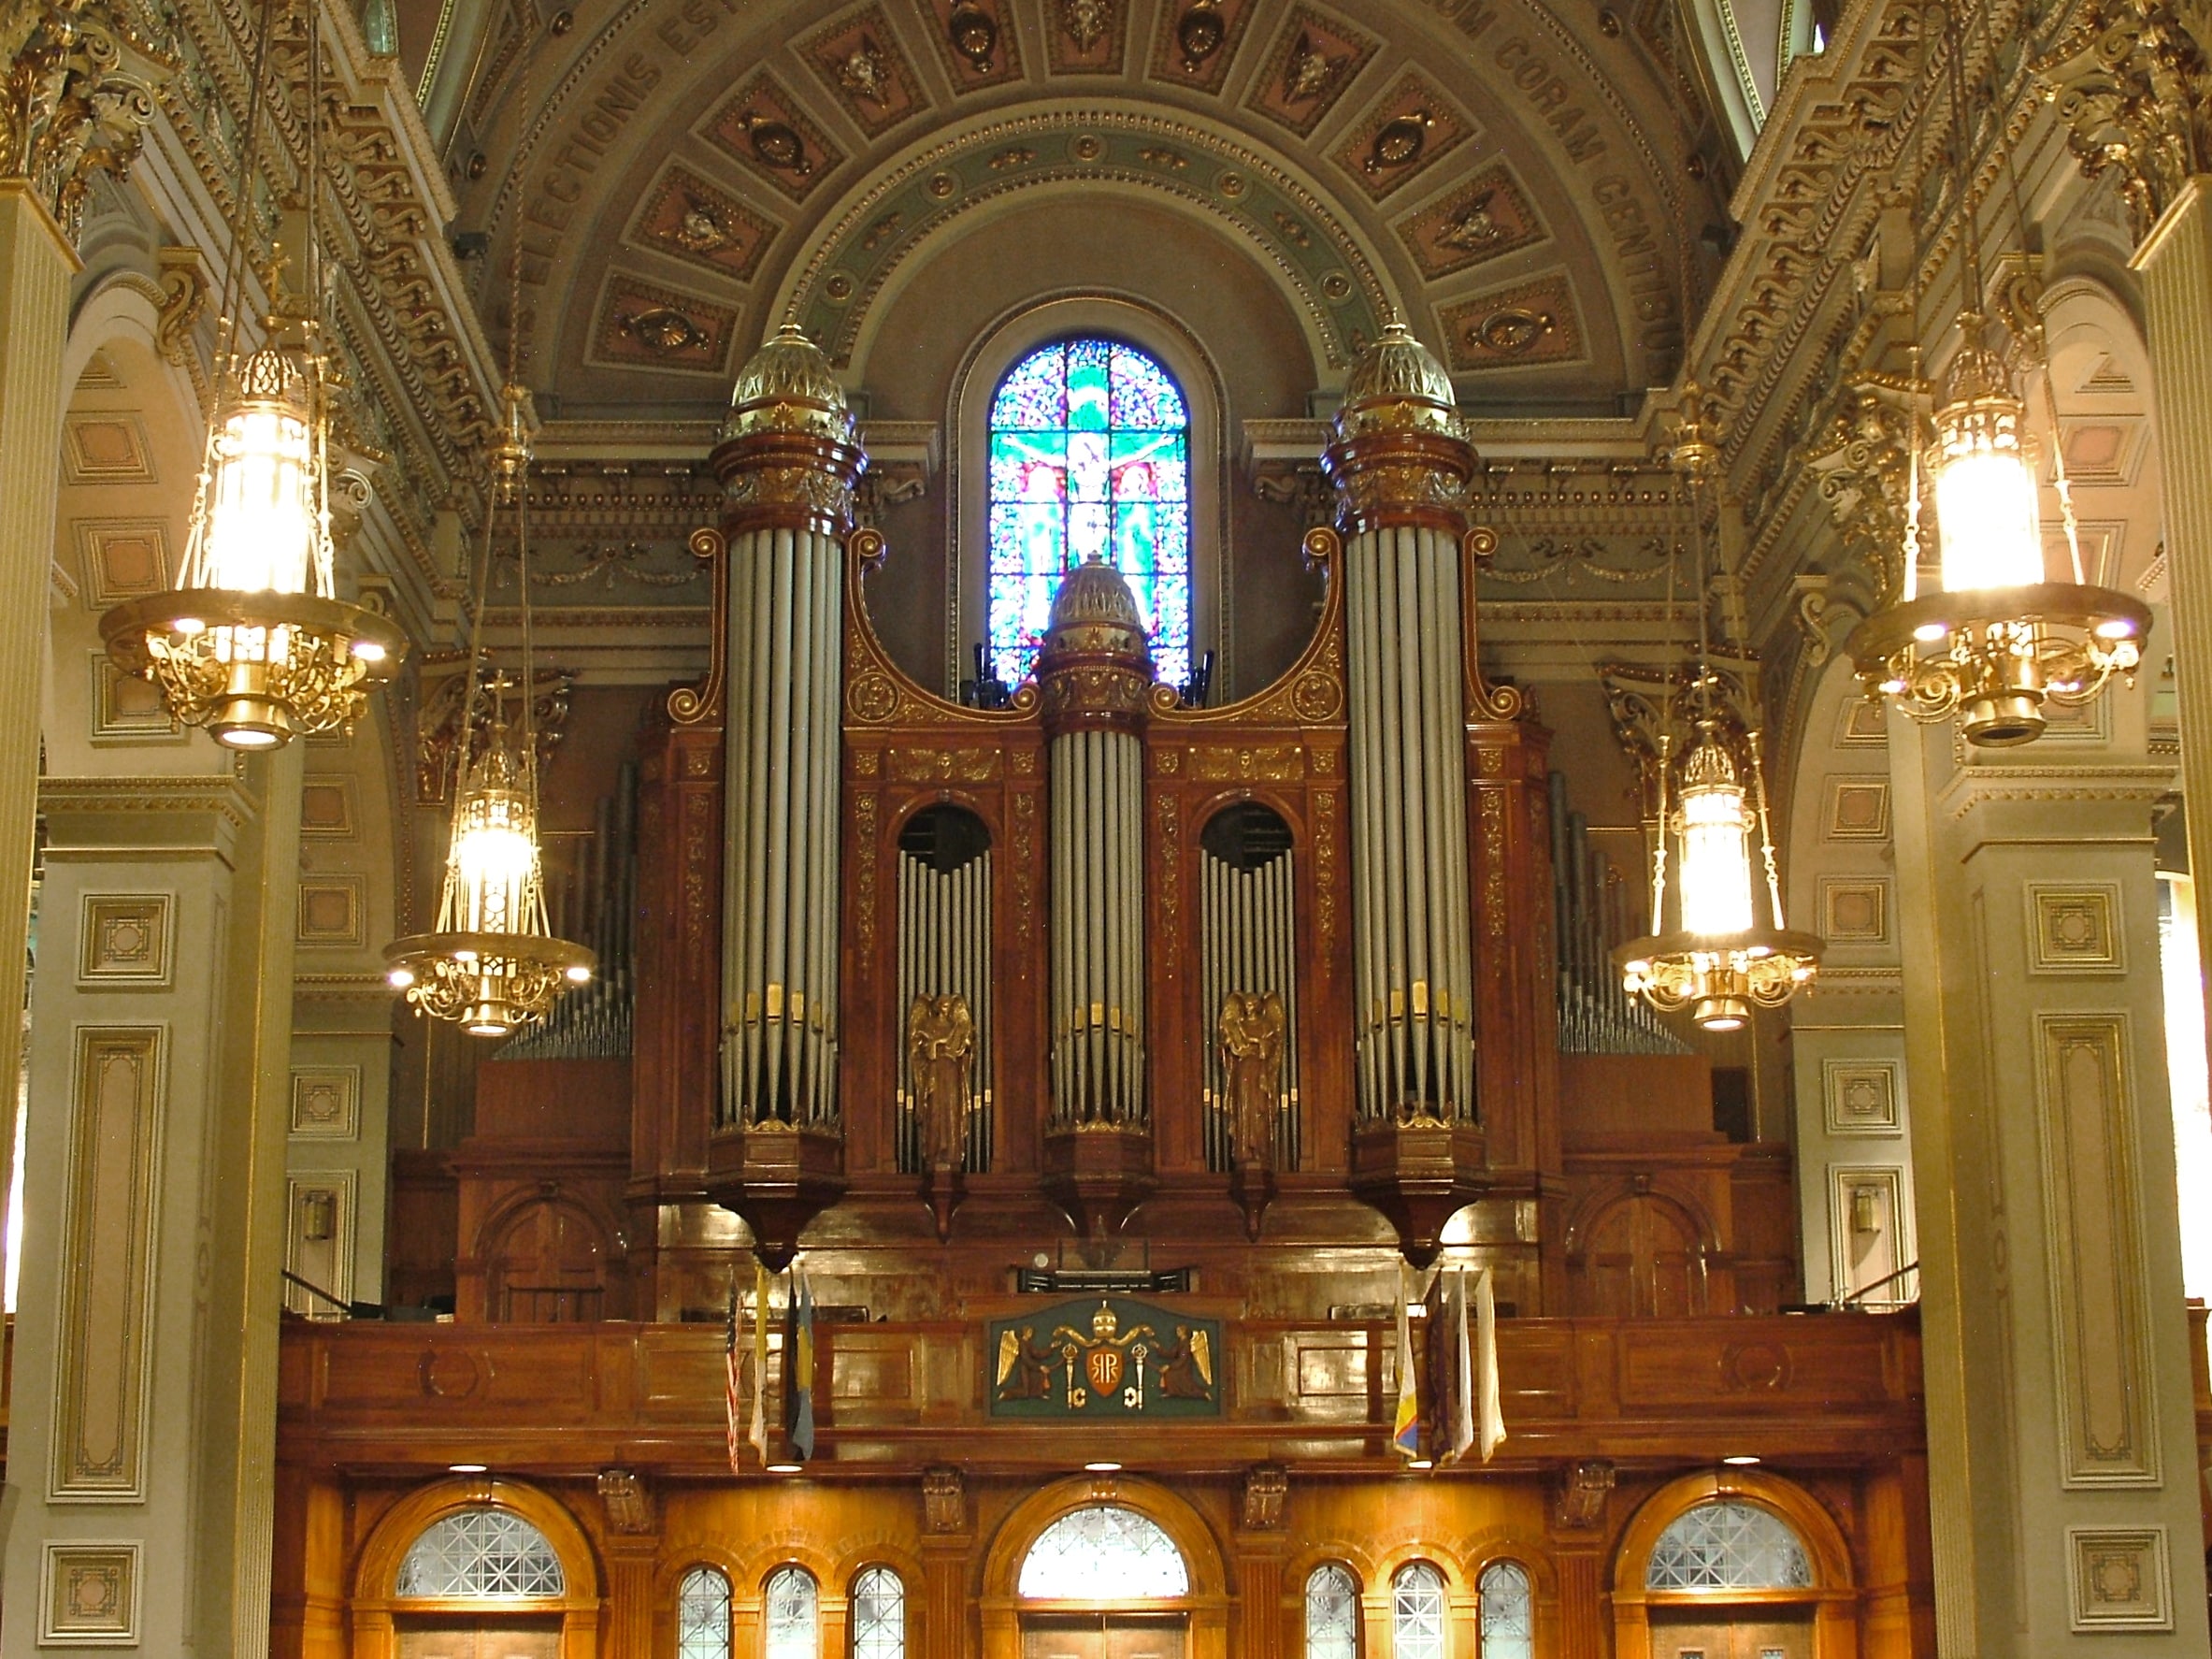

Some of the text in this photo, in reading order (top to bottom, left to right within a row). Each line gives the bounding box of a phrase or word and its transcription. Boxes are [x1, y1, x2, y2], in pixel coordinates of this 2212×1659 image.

[505, 50, 663, 287] ELECTIONIS
[656, 0, 739, 57] ES
[1494, 36, 1608, 166] CORAM
